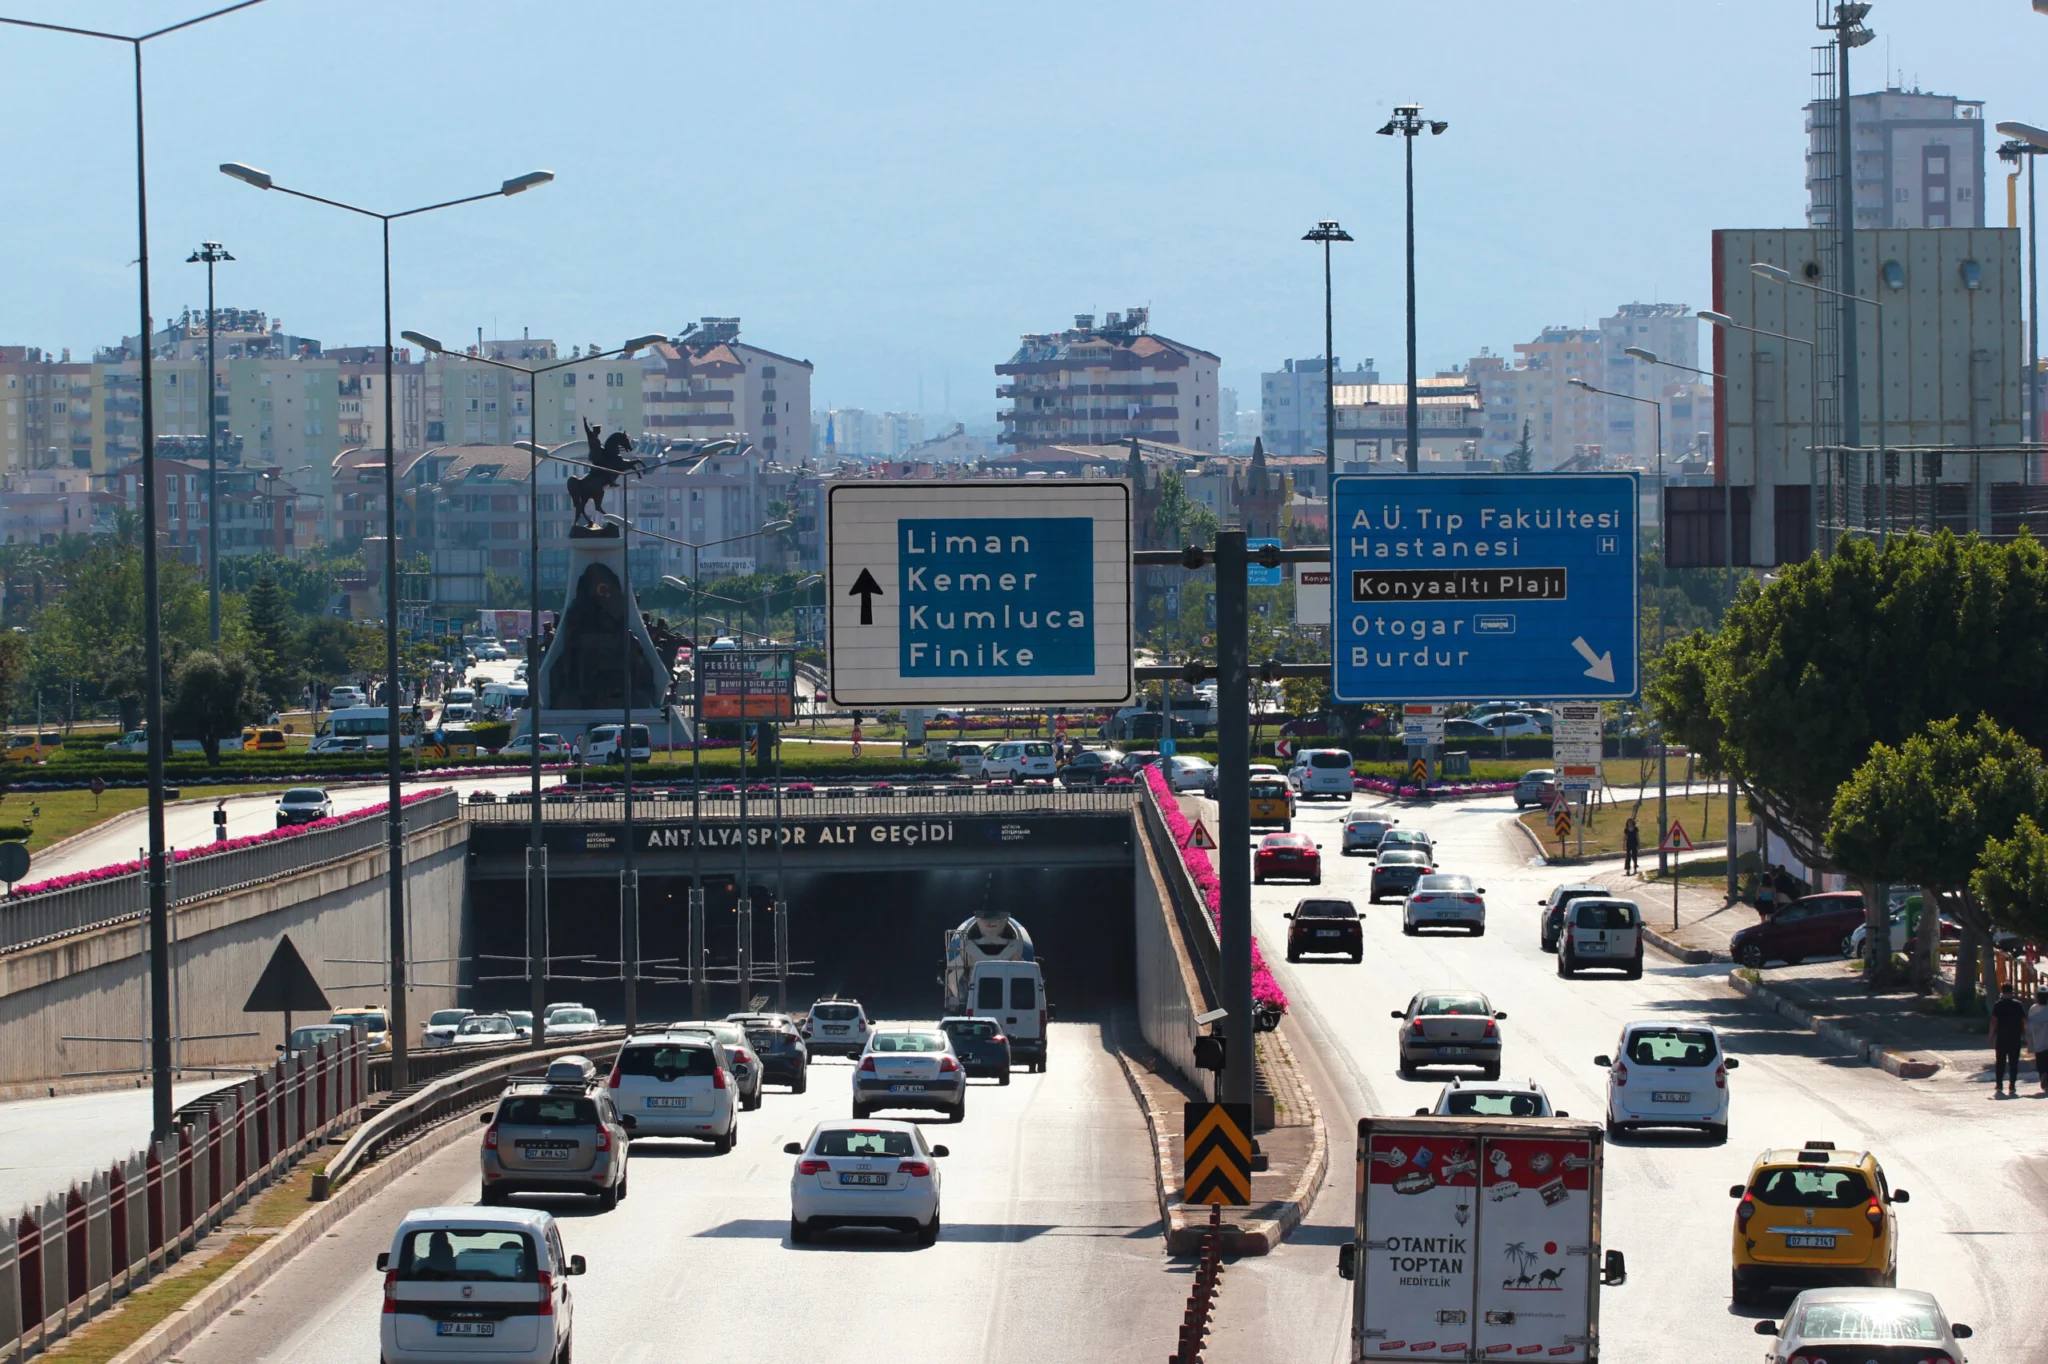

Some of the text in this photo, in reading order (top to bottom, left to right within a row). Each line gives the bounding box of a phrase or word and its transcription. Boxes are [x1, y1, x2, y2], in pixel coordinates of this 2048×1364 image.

[1417, 509, 1463, 535] Tıp
[1481, 508, 1620, 529] Fakültesi
[907, 529, 1030, 554] Liman
[1351, 537, 1519, 558] Hastanesi
[908, 566, 1037, 592] Kemer
[1360, 576, 1559, 598] Konyaaltı Plajı
[909, 605, 1085, 630] Kumluca
[1352, 615, 1464, 640] Otogar
[909, 643, 1034, 668] Finike
[1352, 646, 1469, 668] Burdur
[647, 819, 954, 846] ANTALYASPOR ALT GEÇİDİ
[1387, 1234, 1467, 1254] OTANTİK
[1815, 1238, 1833, 1246] 2141
[1390, 1257, 1463, 1273] TOPTAN
[1400, 1275, 1451, 1288] HEDİYELİK
[443, 1323, 453, 1332] 07
[477, 1324, 492, 1333] 160
